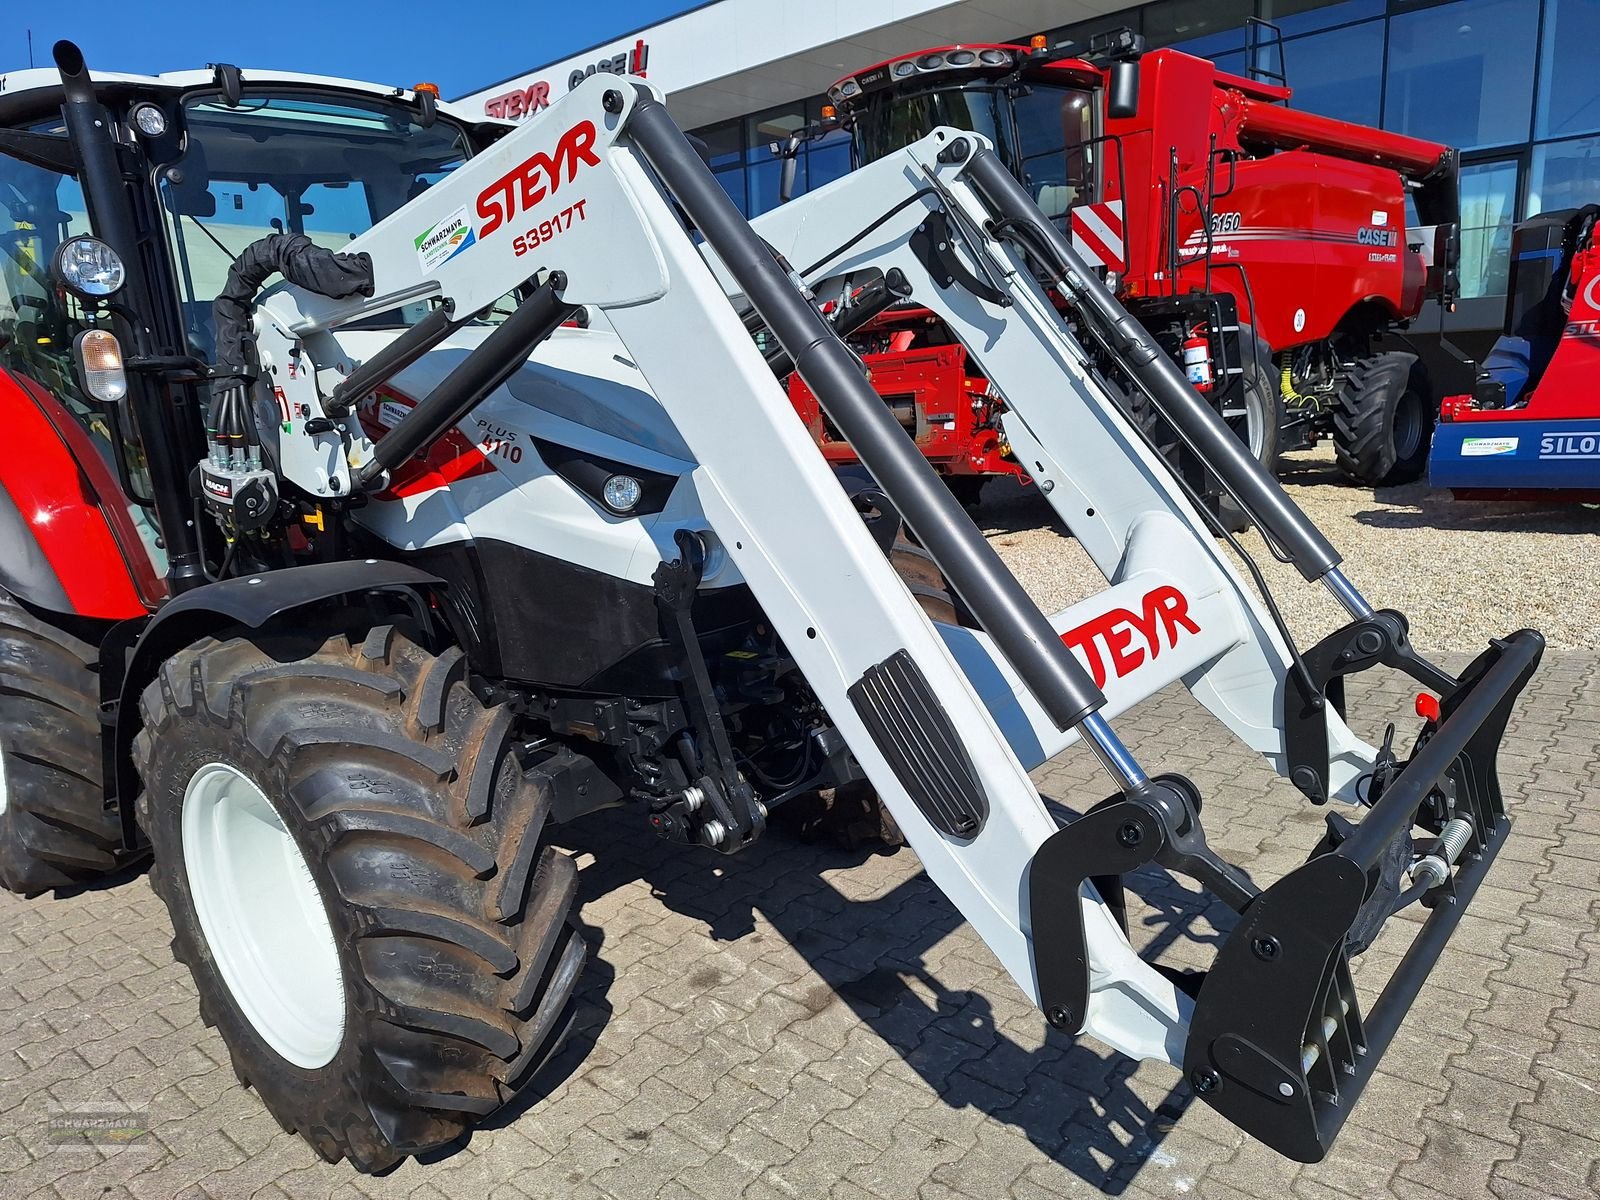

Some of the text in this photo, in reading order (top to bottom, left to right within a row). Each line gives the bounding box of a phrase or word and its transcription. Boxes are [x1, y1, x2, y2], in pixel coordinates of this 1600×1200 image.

[484, 80, 550, 121] STEYR
[476, 119, 602, 241] STEYR
[420, 218, 463, 253] SCHWARZMAYR
[512, 198, 587, 257] S3917T
[1357, 227, 1388, 246] CASE
[477, 419, 518, 442] PLUS
[1540, 437, 1600, 454] SILO
[482, 433, 523, 464] 4110
[1060, 585, 1202, 690] TEYR
